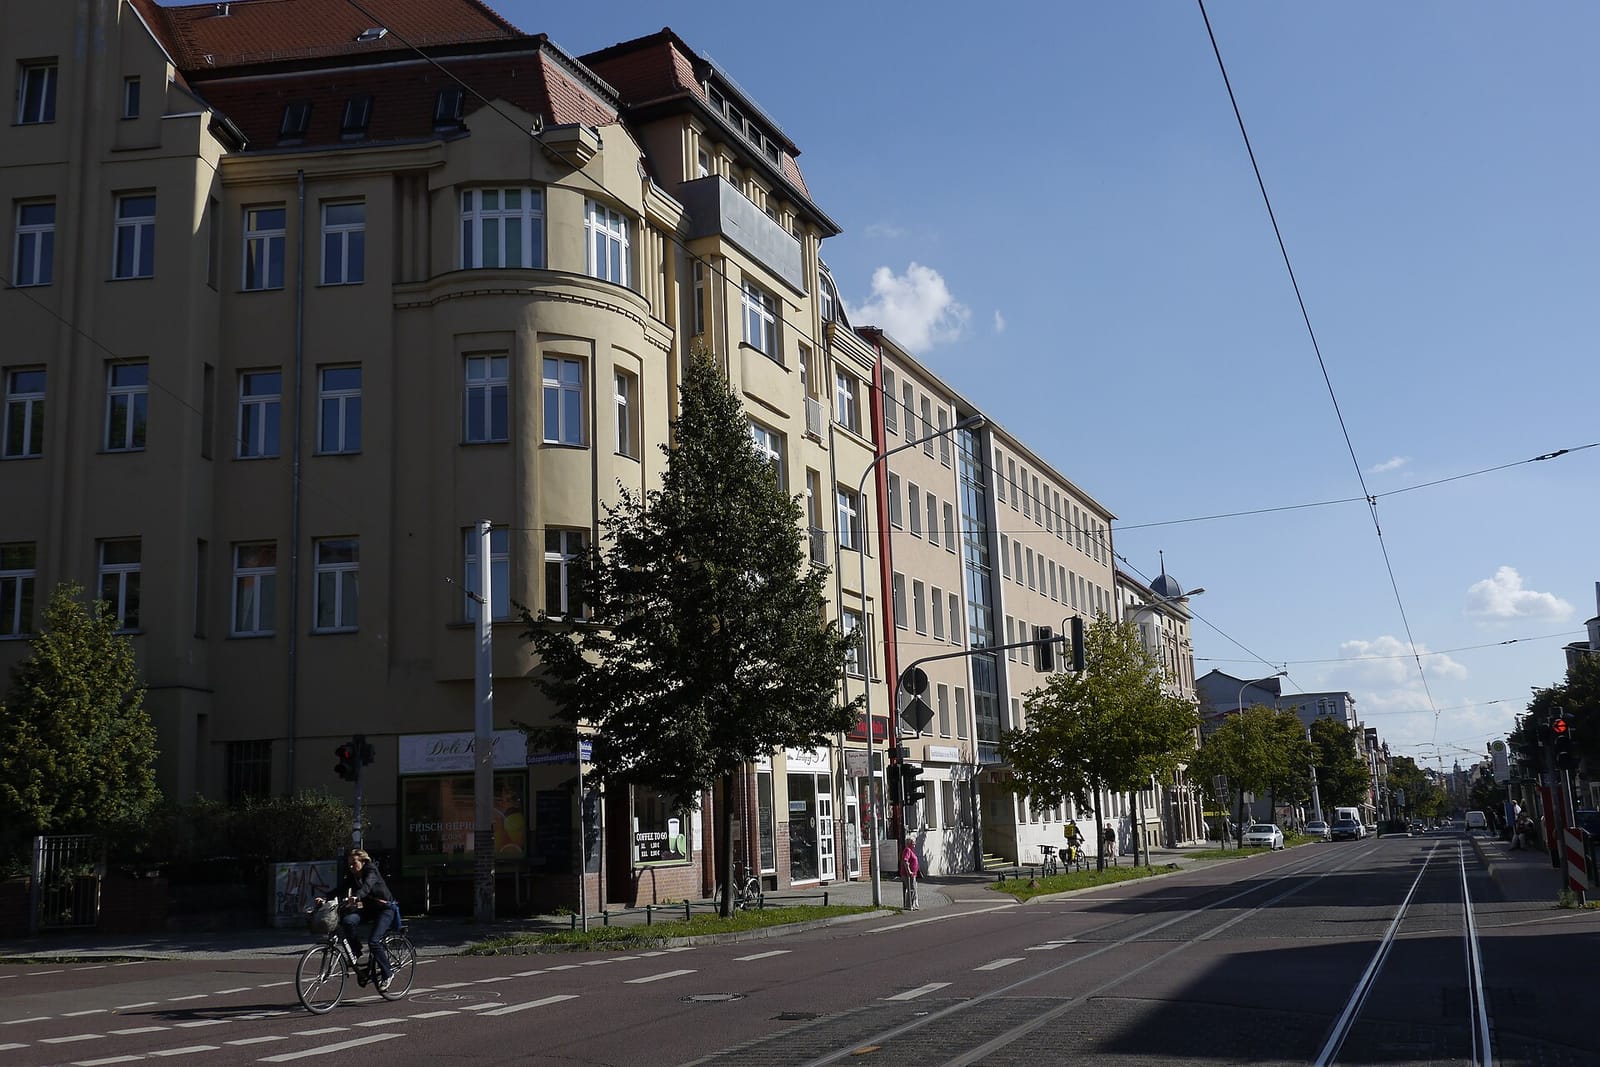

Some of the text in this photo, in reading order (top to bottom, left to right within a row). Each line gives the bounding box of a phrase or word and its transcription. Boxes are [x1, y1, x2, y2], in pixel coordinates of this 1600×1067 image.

[431, 739, 460, 755] Deli
[409, 822, 443, 833] FRISCH
[636, 832, 668, 841] COFFEE TO GO
